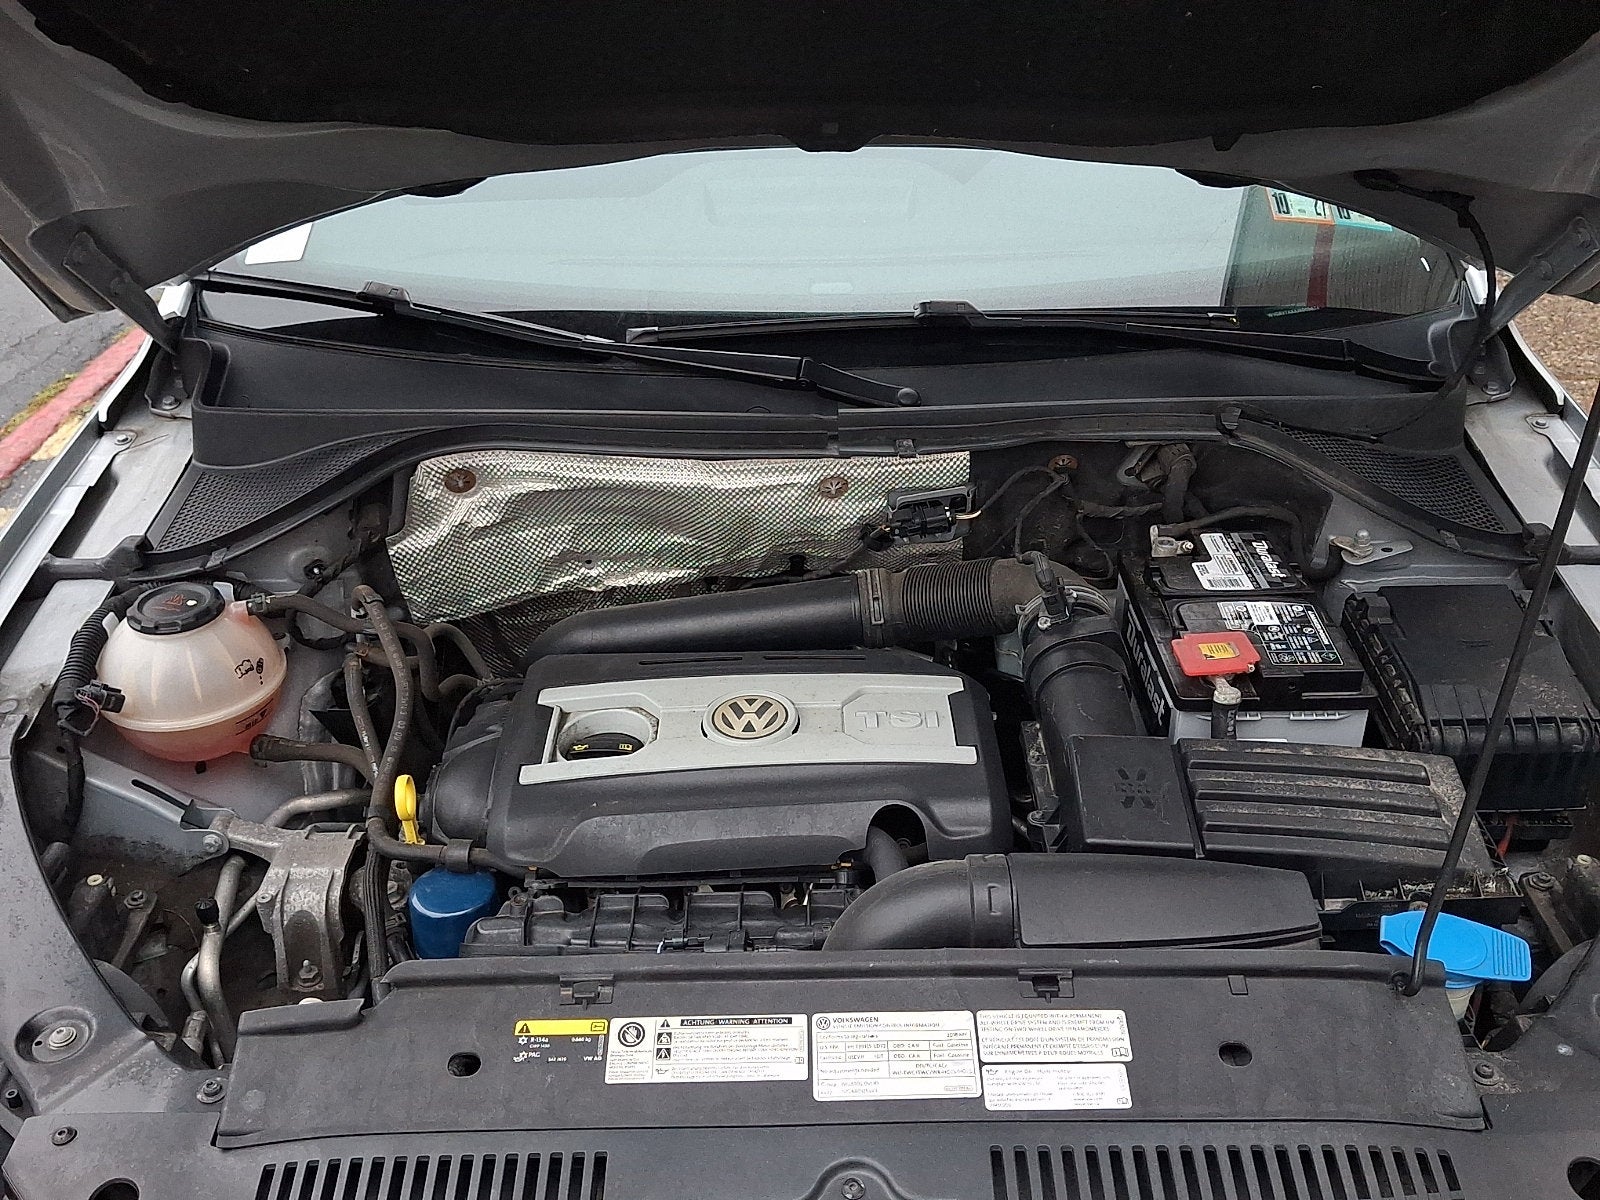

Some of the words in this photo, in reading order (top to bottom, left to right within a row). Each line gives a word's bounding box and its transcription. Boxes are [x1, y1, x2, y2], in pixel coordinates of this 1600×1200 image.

[1272, 192, 1290, 215] 10
[1251, 540, 1287, 579] Duralast
[1126, 623, 1166, 727] Duralast
[855, 711, 940, 729] TSI
